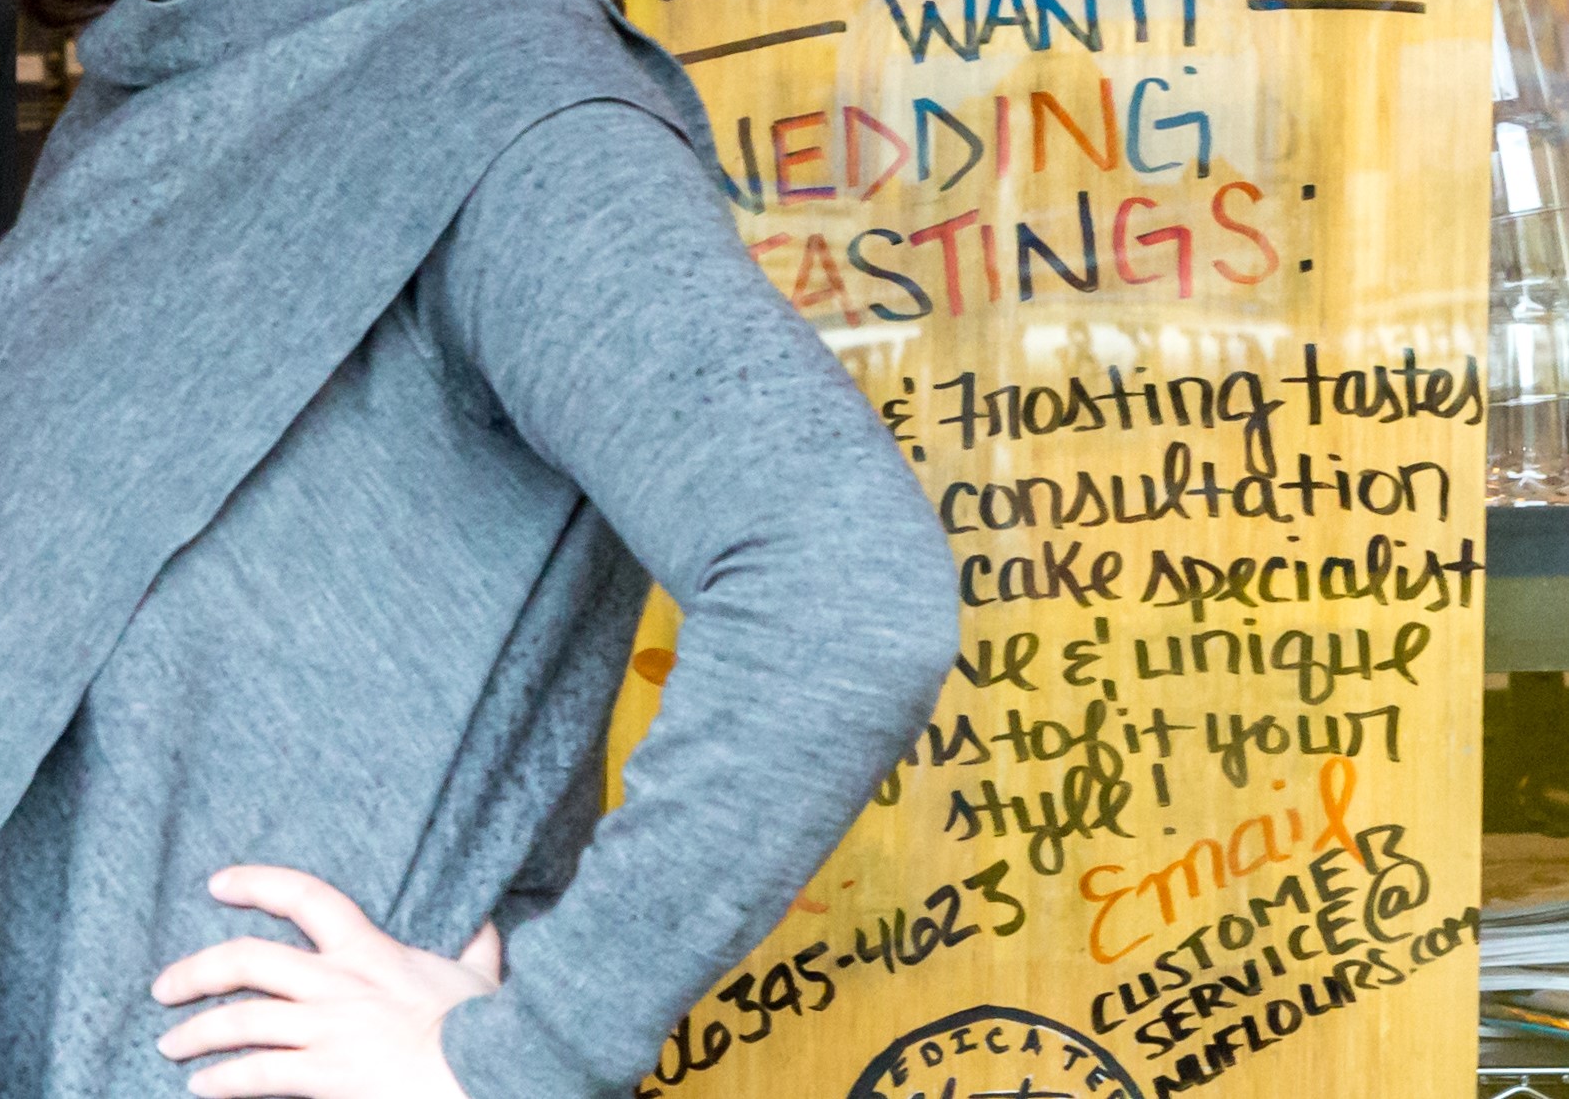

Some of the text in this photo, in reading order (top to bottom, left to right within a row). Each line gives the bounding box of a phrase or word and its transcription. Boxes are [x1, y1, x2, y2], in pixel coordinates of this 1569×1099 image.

[1282, 344, 1484, 427] tastes
[940, 442, 1451, 535] consultation
[960, 535, 1484, 622] cake specialist
[1063, 617, 1118, 701] &
[1135, 618, 1432, 704] unique
[1208, 706, 1403, 786] your
[1079, 756, 1366, 965] Email
[1091, 824, 1407, 1035] CUSTOMER
[1134, 856, 1430, 1061] SERVICE@
